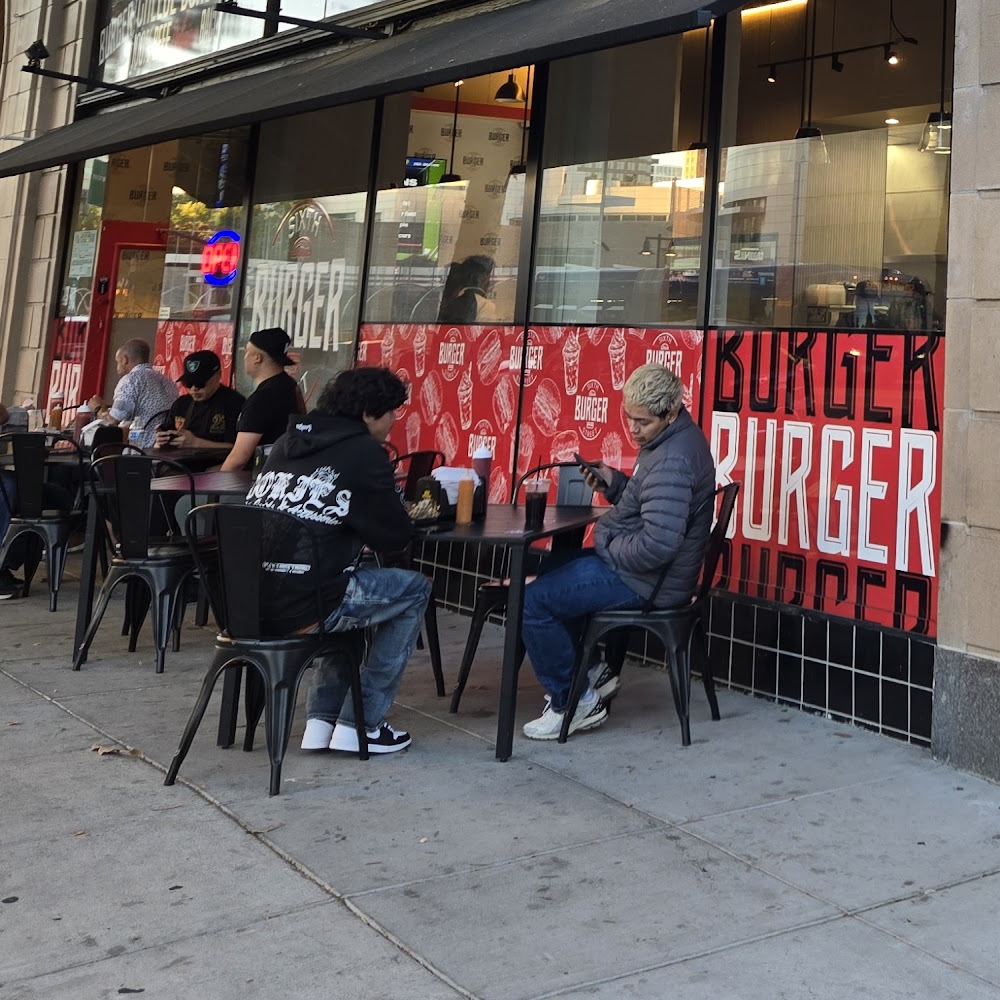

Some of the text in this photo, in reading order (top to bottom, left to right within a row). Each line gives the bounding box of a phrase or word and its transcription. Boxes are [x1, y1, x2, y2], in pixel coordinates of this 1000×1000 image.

[288, 207, 322, 239] SIXTH
[252, 258, 346, 352] BURGER
[439, 342, 465, 366] BURGER
[575, 395, 608, 423] BURGER
[710, 411, 937, 577] BURGER
